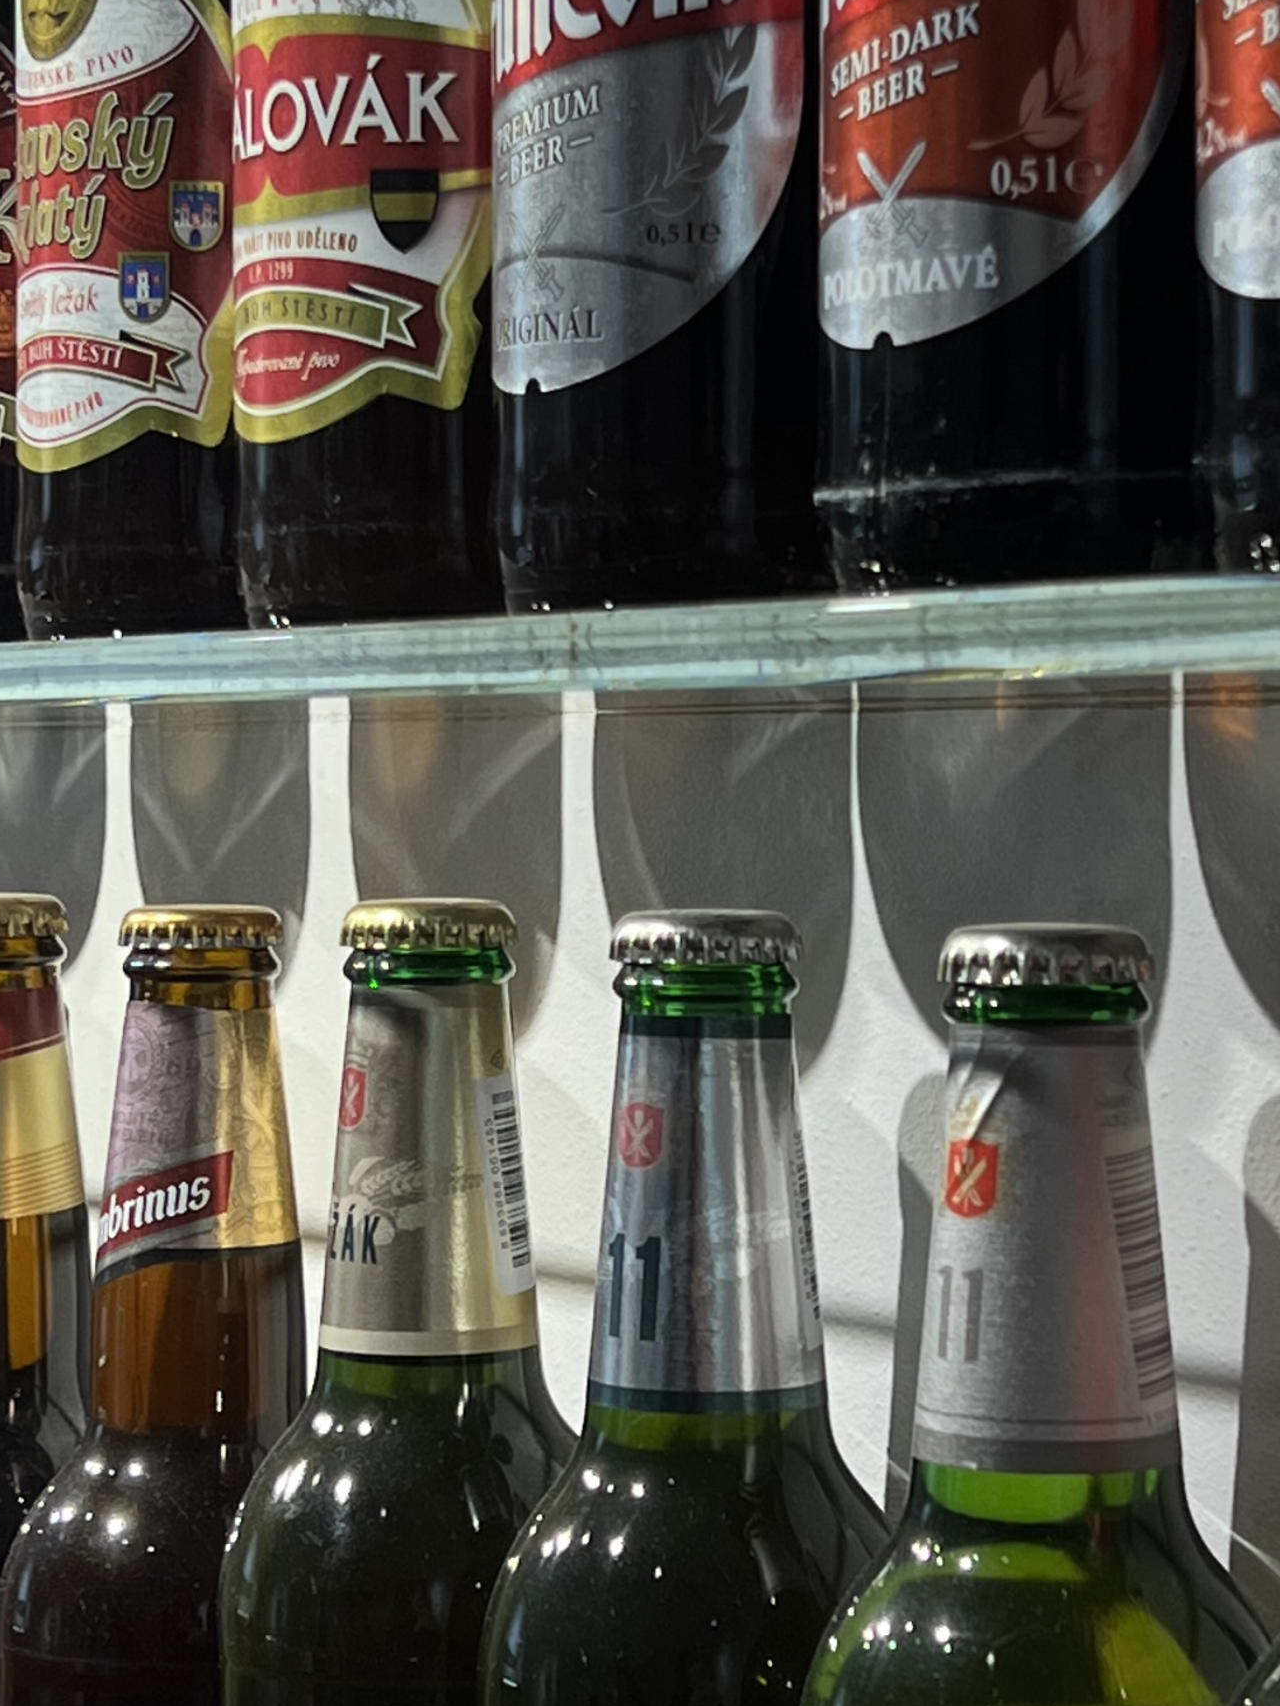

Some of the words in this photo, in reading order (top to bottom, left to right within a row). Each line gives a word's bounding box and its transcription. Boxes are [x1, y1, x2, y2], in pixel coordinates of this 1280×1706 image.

[830, 0, 982, 99] SEMI-DARK
[856, 65, 926, 121] BEER
[508, 138, 566, 189] BEER
